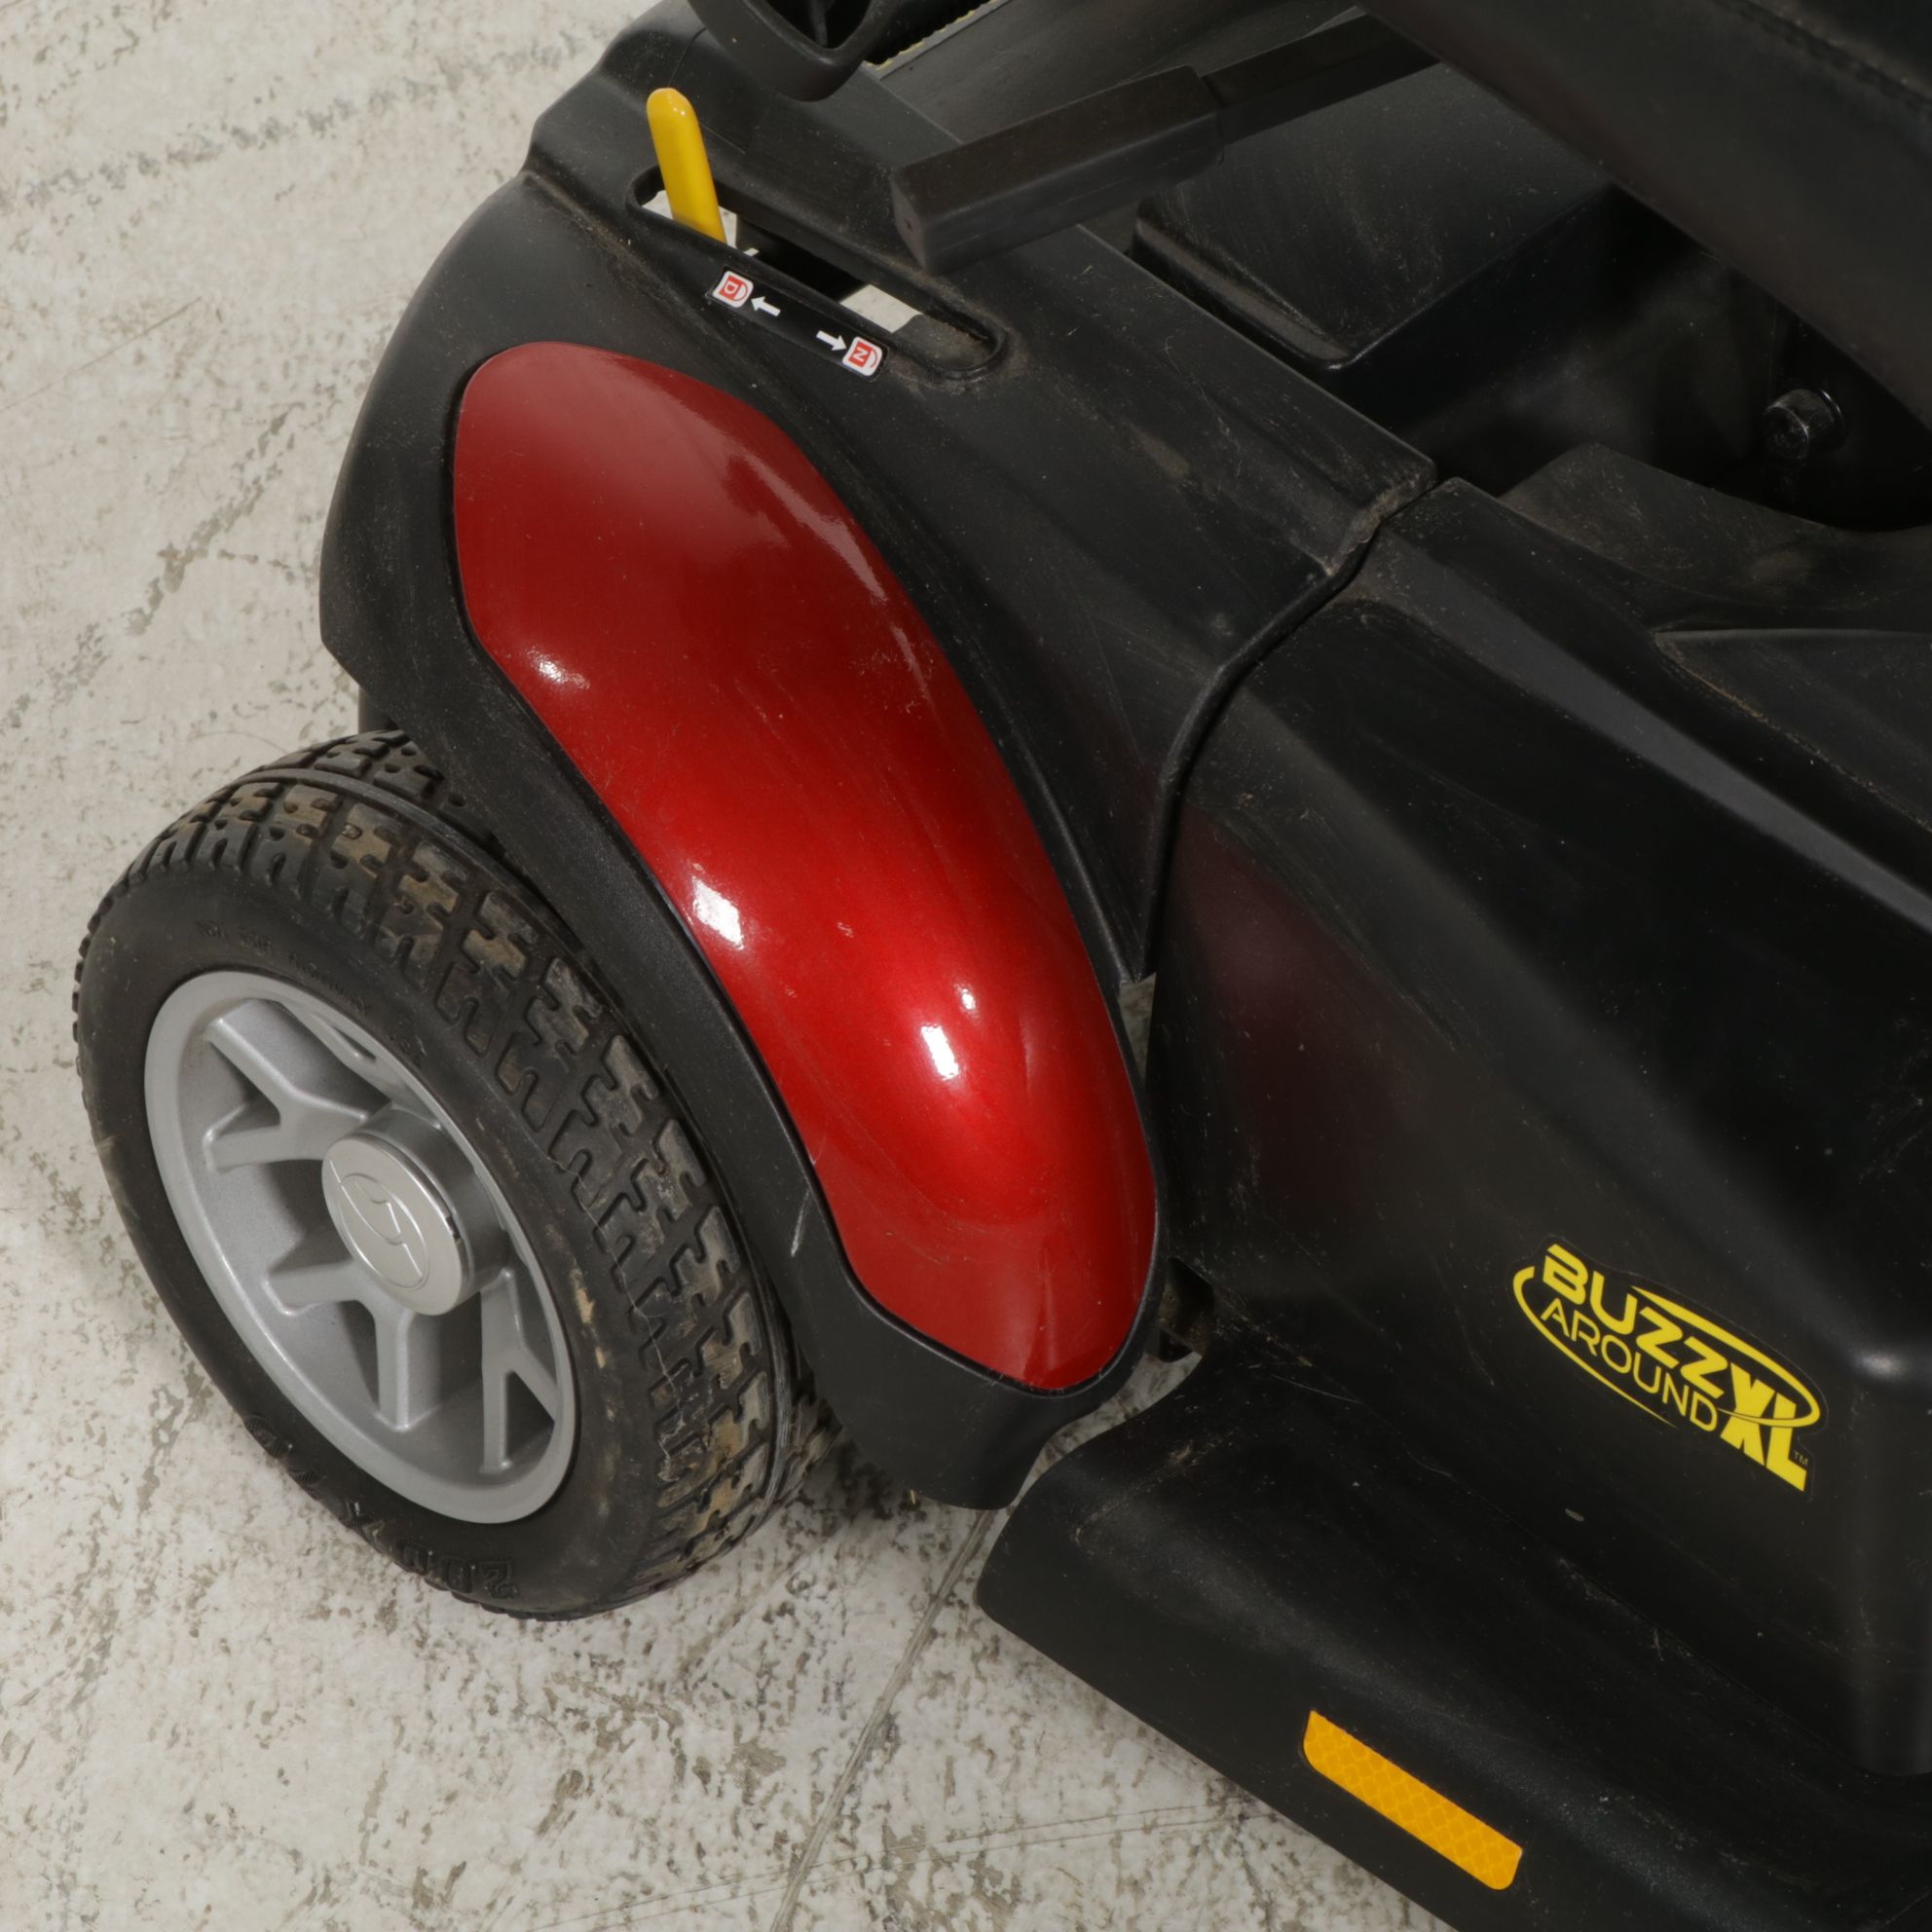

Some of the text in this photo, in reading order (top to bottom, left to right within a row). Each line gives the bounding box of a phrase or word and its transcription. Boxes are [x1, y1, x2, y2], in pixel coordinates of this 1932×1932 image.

[1541, 1298, 1718, 1432] AROUND
[1542, 1244, 1728, 1399] BUZZ
[1720, 1362, 1807, 1492] XL
